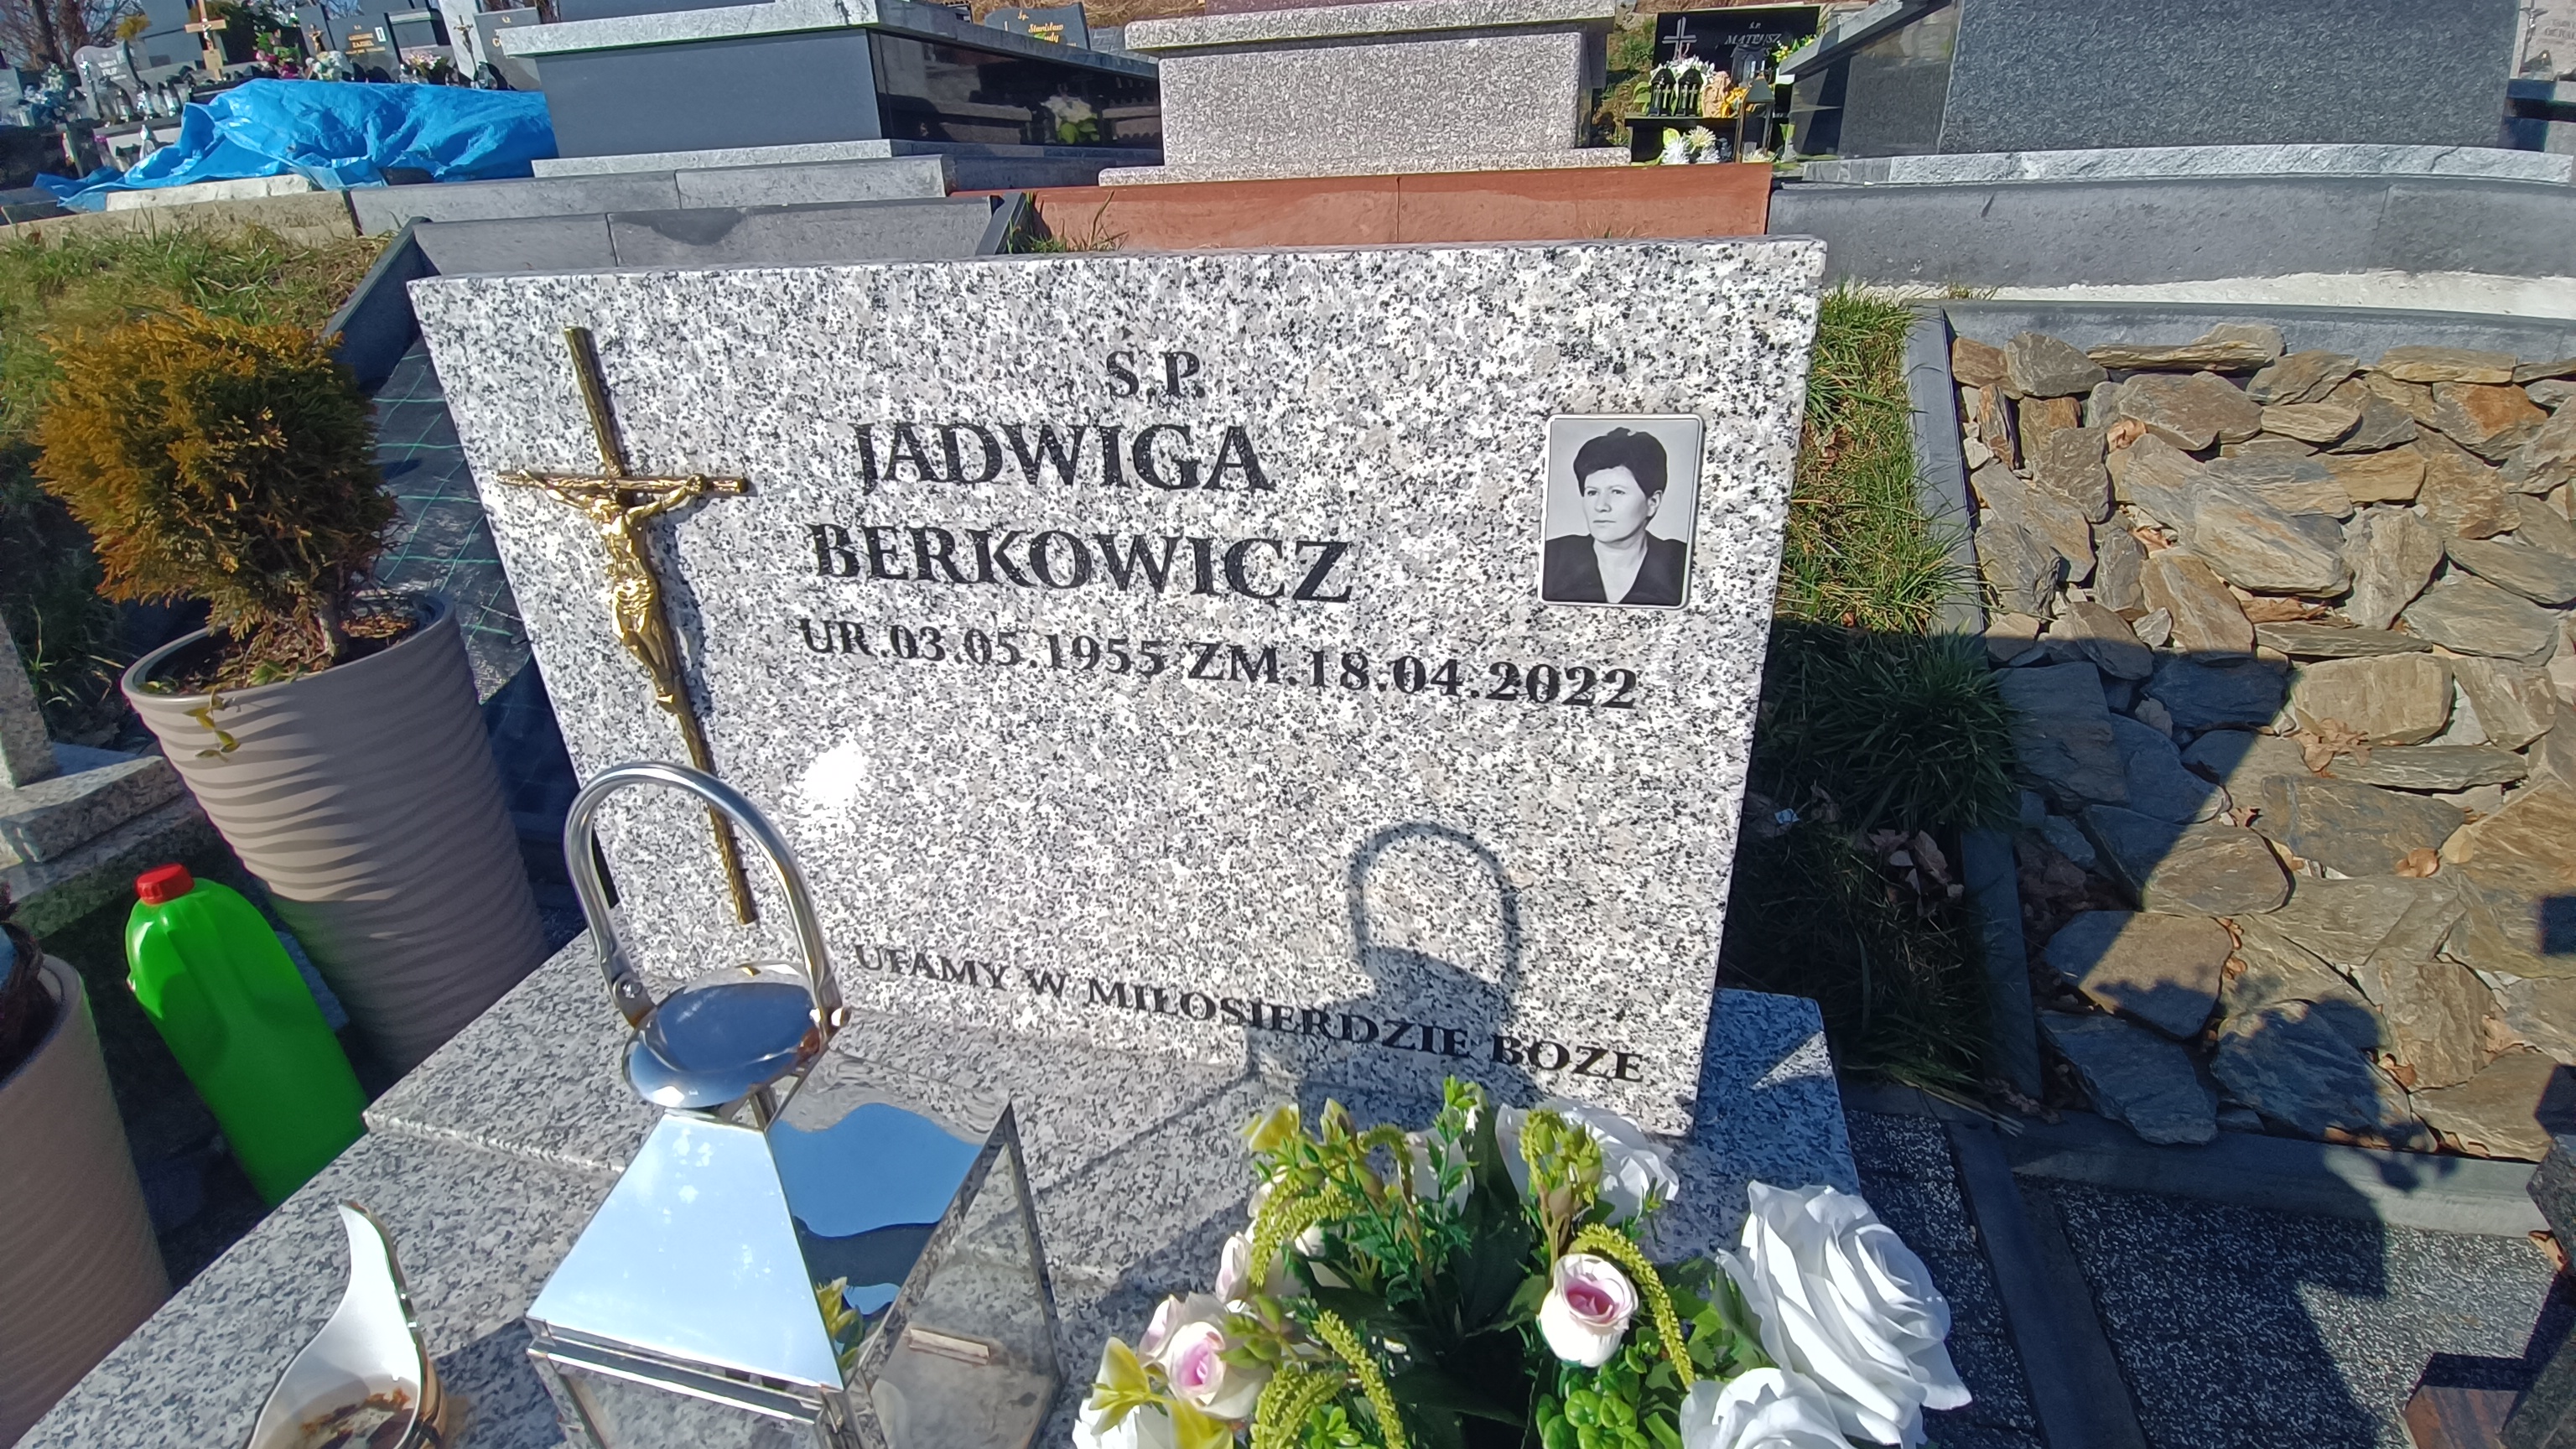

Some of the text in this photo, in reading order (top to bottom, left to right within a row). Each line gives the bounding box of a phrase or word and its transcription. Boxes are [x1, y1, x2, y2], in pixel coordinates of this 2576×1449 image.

[848, 419, 1276, 496] JADWIGA
[807, 523, 1352, 604] BERKOWICZ
[854, 943, 1008, 991] UFAMY
[1023, 969, 1072, 998] W
